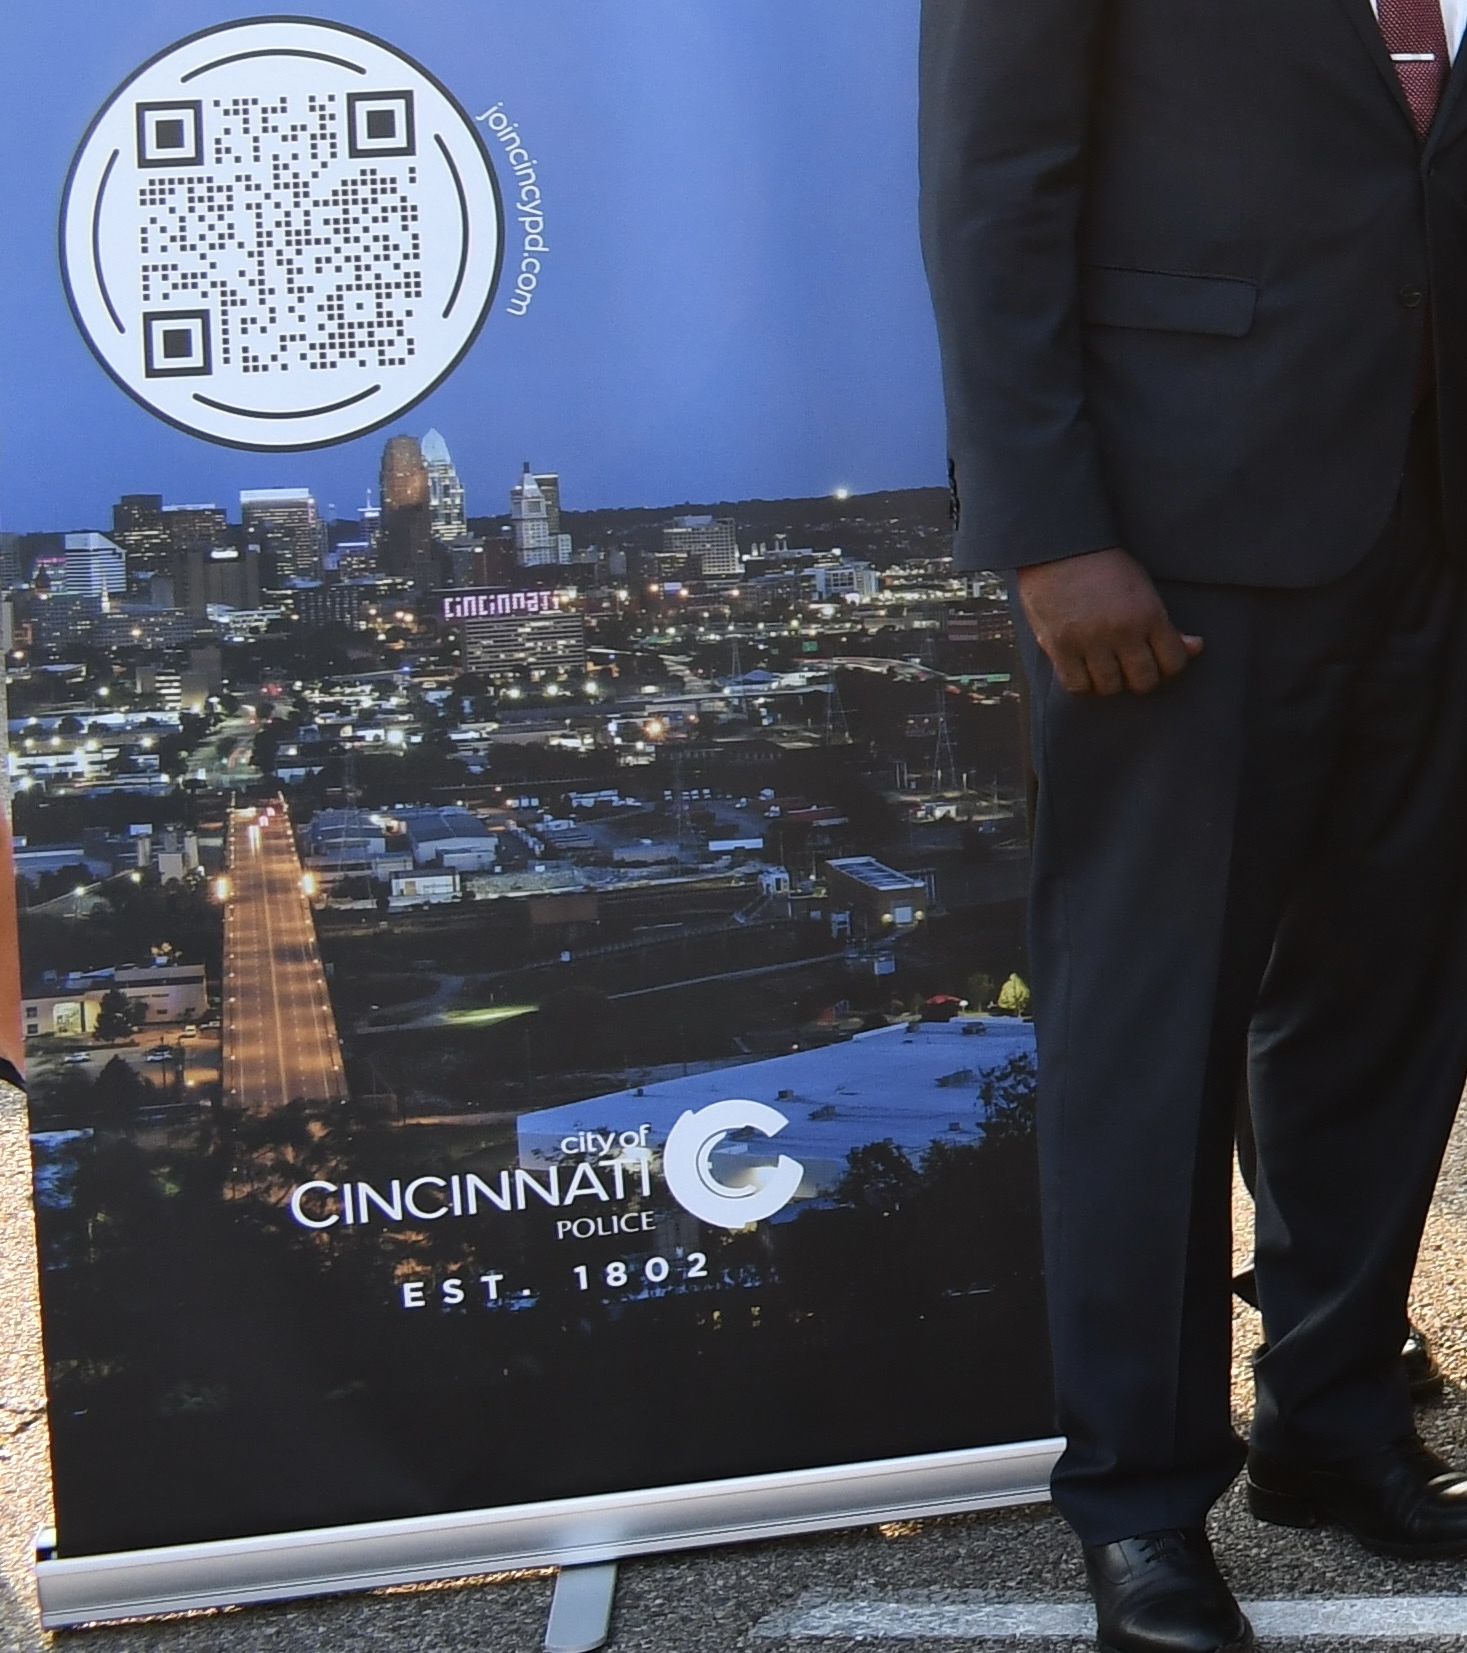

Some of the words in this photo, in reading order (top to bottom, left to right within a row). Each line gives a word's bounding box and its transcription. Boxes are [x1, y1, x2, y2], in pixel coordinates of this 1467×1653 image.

[475, 101, 550, 316] joincincypd.com
[560, 1130, 611, 1157] city
[611, 1123, 651, 1148] of
[291, 1157, 652, 1229] CINCINNATI
[556, 1211, 656, 1241] POLICE
[402, 1273, 532, 1309] EST.
[572, 1252, 709, 1291] 1802
